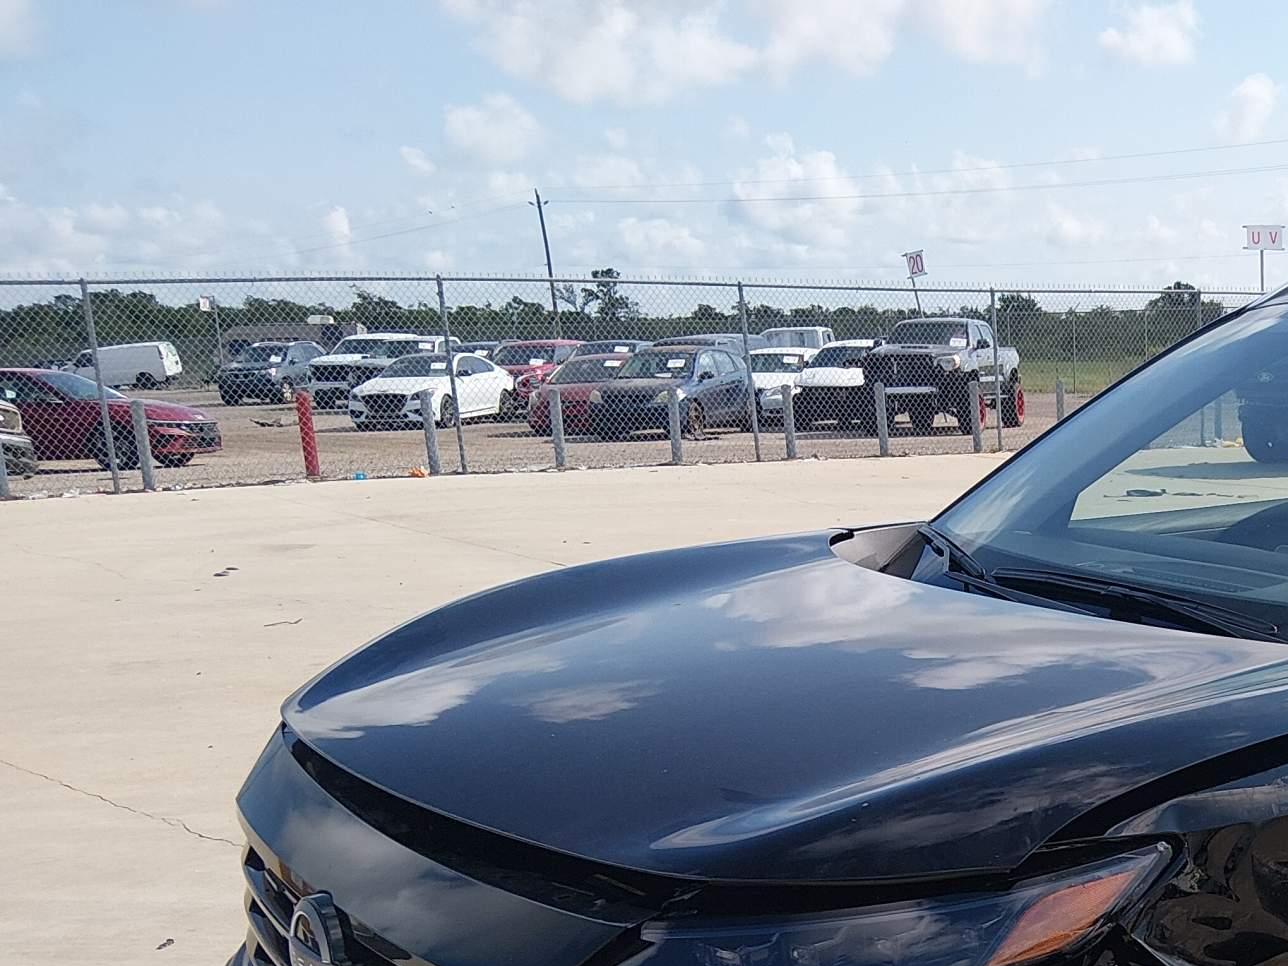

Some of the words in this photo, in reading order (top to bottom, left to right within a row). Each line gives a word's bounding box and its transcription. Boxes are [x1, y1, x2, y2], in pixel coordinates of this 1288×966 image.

[1251, 231, 1261, 245] U
[1268, 231, 1278, 245] V
[909, 254, 924, 275] 20
